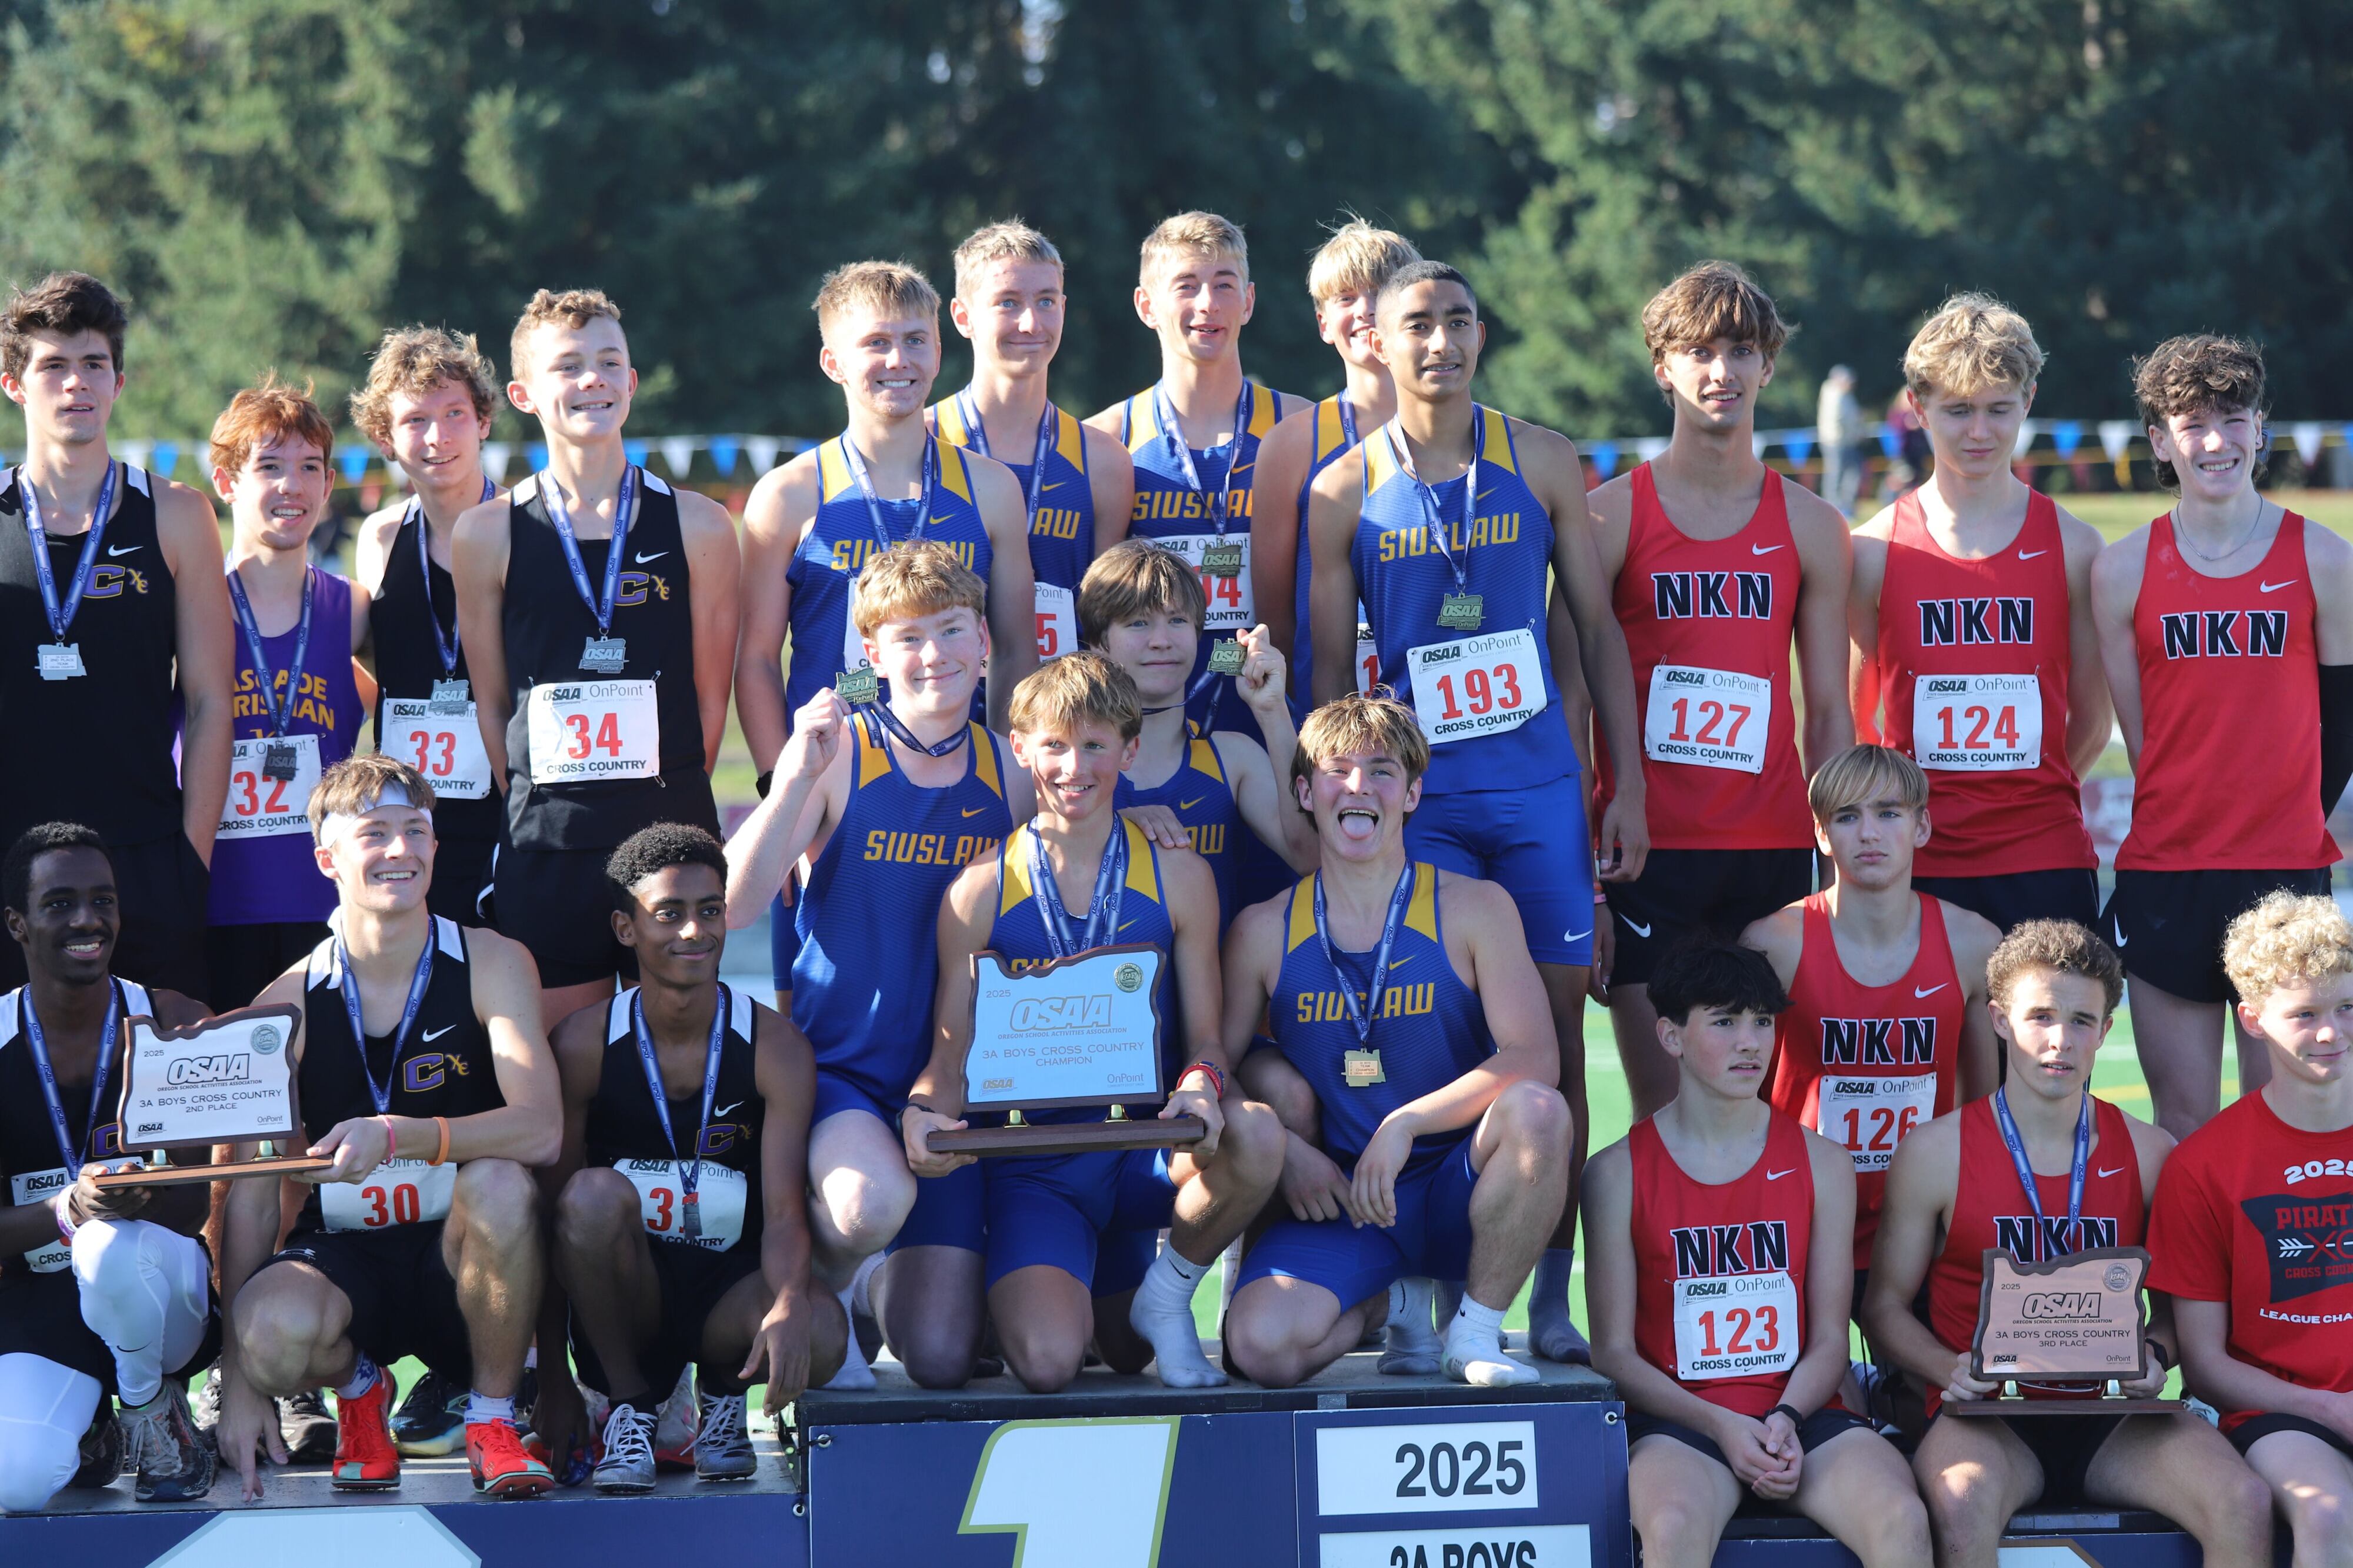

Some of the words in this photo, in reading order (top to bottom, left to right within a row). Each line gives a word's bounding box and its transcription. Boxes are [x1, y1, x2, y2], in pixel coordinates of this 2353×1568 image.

[1203, 554, 1241, 566] OSAA
[615, 572, 649, 606] C
[1035, 585, 1064, 599] Point
[1651, 572, 1773, 620] NKN
[1205, 611, 1249, 620] OUNTRY
[1442, 604, 1481, 618] OSAA
[1917, 597, 2034, 647] NKN
[2159, 610, 2288, 660] NKN
[584, 648, 624, 660] OSAA
[1422, 645, 1462, 663] OSAA
[1468, 633, 1521, 654] OnPoint
[234, 669, 327, 700] SADE
[838, 676, 876, 695] OSAA
[1666, 670, 1705, 685] OSAA
[1712, 673, 1760, 693] OnPoint
[1928, 680, 1967, 692] OSAA
[1975, 678, 2027, 691] OnPoint
[432, 690, 467, 702] OSAA
[543, 688, 581, 702] OSAA
[589, 684, 643, 698] OnPoint
[1437, 663, 1522, 721] 193
[394, 704, 425, 716] OSAA
[1435, 719, 1474, 735] CROSS
[1477, 709, 1534, 728] COUNTRY
[1668, 698, 1751, 748] 127
[1938, 705, 2019, 750] 124
[566, 712, 624, 759] 34
[267, 755, 295, 768] OSAA
[408, 730, 456, 776] 33
[1658, 743, 1697, 756] CROSS
[1700, 748, 1754, 763] COUNTRY
[1929, 753, 1967, 762] CROSS
[1971, 752, 2027, 762] COUNTRY
[547, 763, 585, 774] CROSS
[589, 760, 646, 771] COUNTRY
[234, 771, 289, 816] 32
[426, 780, 475, 790] OUNTRY
[258, 815, 308, 828] COUNTRY
[1102, 855, 1111, 872] OSAA
[1092, 896, 1100, 913] OSAA
[1396, 889, 1405, 906] OSAA
[1385, 926, 1394, 945] OSAA
[1377, 968, 1385, 986] OSAA
[986, 989, 1011, 998] 2025
[1297, 982, 1435, 1022] SIUAW
[1010, 994, 1112, 1032] OSAA
[1820, 1017, 1937, 1065] NKN
[982, 1050, 998, 1059] 3A
[1004, 1048, 1036, 1057] BOYS
[1041, 1046, 1082, 1055] CROSS
[1088, 1042, 1145, 1053] COUNTRY
[167, 1053, 250, 1085] OSAA
[1036, 1057, 1092, 1066] CHAMPION
[403, 1053, 445, 1092] C
[1107, 1073, 1144, 1083] OnPoint
[982, 1078, 1014, 1089] OSAA
[1835, 1081, 1874, 1094] OSAA
[1883, 1078, 1927, 1093] OnPoint
[158, 1097, 186, 1106] BOYS
[191, 1094, 227, 1103] CROSS
[232, 1089, 282, 1100] COUNTRY
[208, 1103, 238, 1111] PLACE
[138, 1123, 163, 1132] OSAA
[257, 1115, 283, 1123] OnPoint
[1842, 1106, 1918, 1151] 126
[695, 1124, 737, 1156] C
[629, 1159, 671, 1173] OSAA
[679, 1160, 734, 1179] OPoint
[27, 1173, 65, 1190] OSAA
[362, 1183, 420, 1227] 30
[2275, 1203, 2353, 1230] PIRAT
[1670, 1220, 1789, 1278] NKN
[1993, 1216, 2117, 1265] NKN
[39, 1252, 71, 1265] CROS
[2285, 1266, 2321, 1279] CROSS
[1687, 1282, 1728, 1296] OSAA
[1735, 1277, 1785, 1292] OnPoint
[2022, 1293, 2101, 1319] OSAA
[2259, 1307, 2321, 1324] LEAGUE
[1698, 1306, 1778, 1356] 123
[1692, 1359, 1731, 1371] CROSS
[1735, 1353, 1787, 1368] COUNTRY
[1395, 1440, 1526, 1497] 2025
